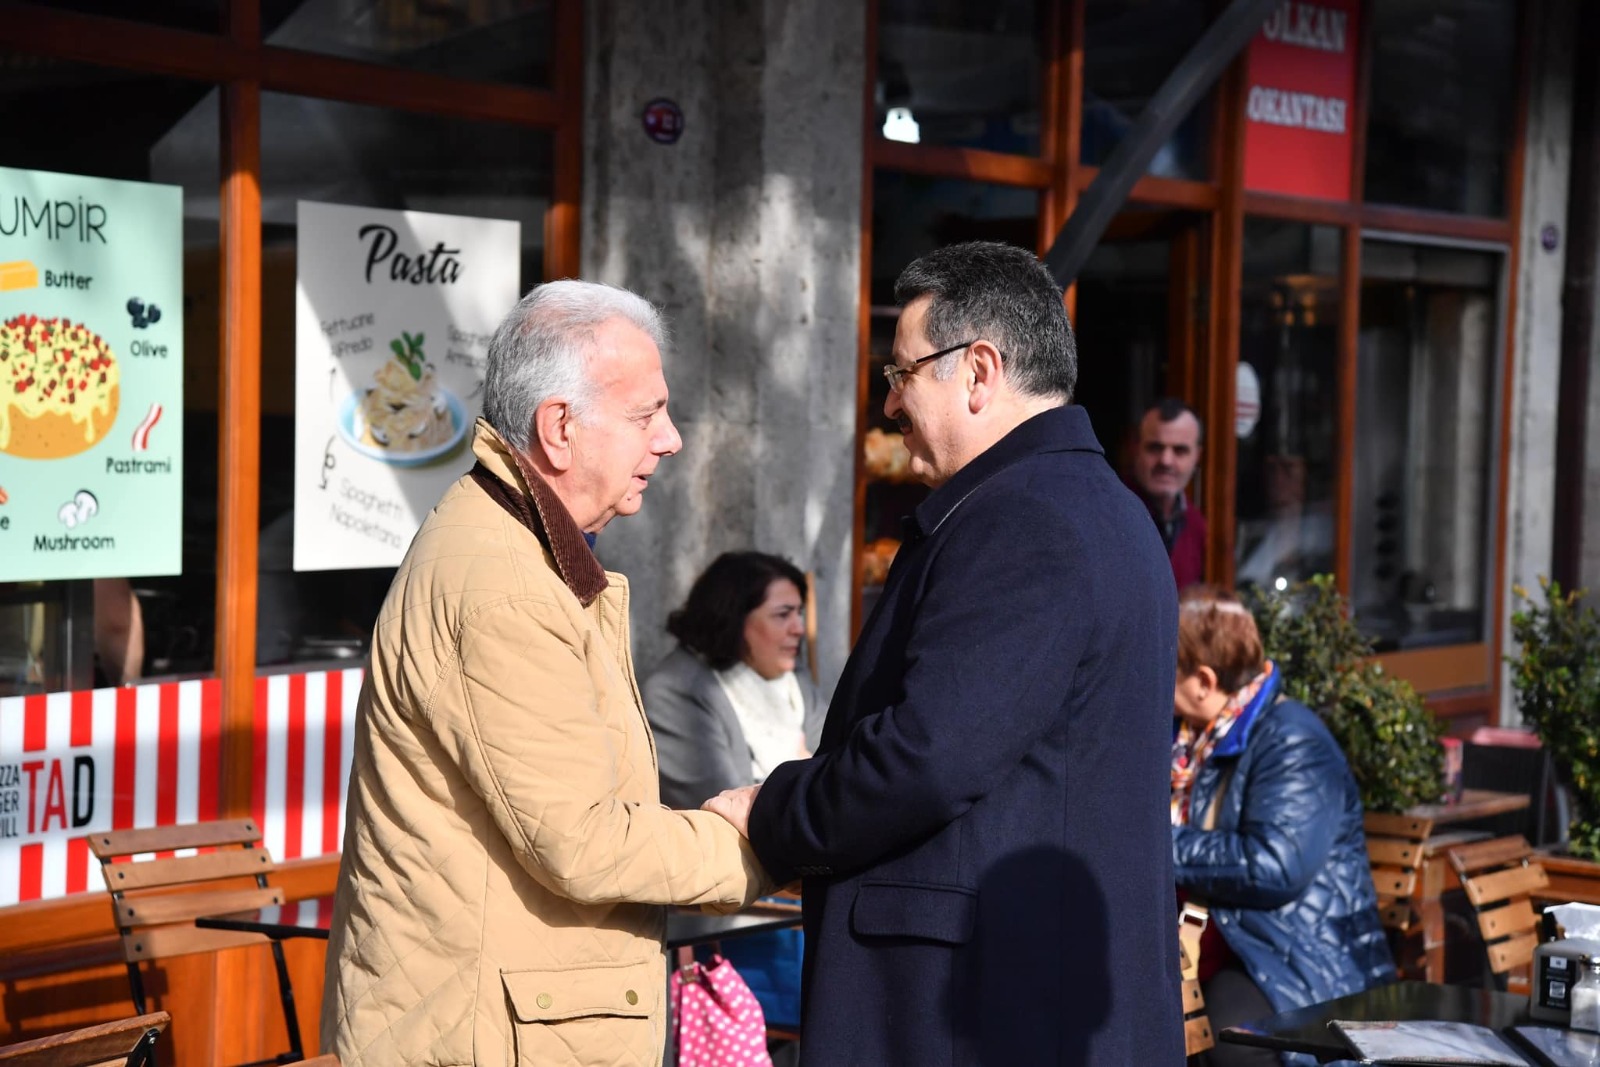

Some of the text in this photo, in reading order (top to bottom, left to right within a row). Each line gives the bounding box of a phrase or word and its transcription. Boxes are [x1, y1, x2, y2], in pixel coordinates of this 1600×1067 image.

[358, 223, 461, 285] Pasta
[44, 269, 93, 290] Butter
[130, 340, 168, 359] Olive
[106, 457, 171, 474] Pastrami
[33, 535, 115, 551] Mushroom
[22, 755, 95, 834] TAD
